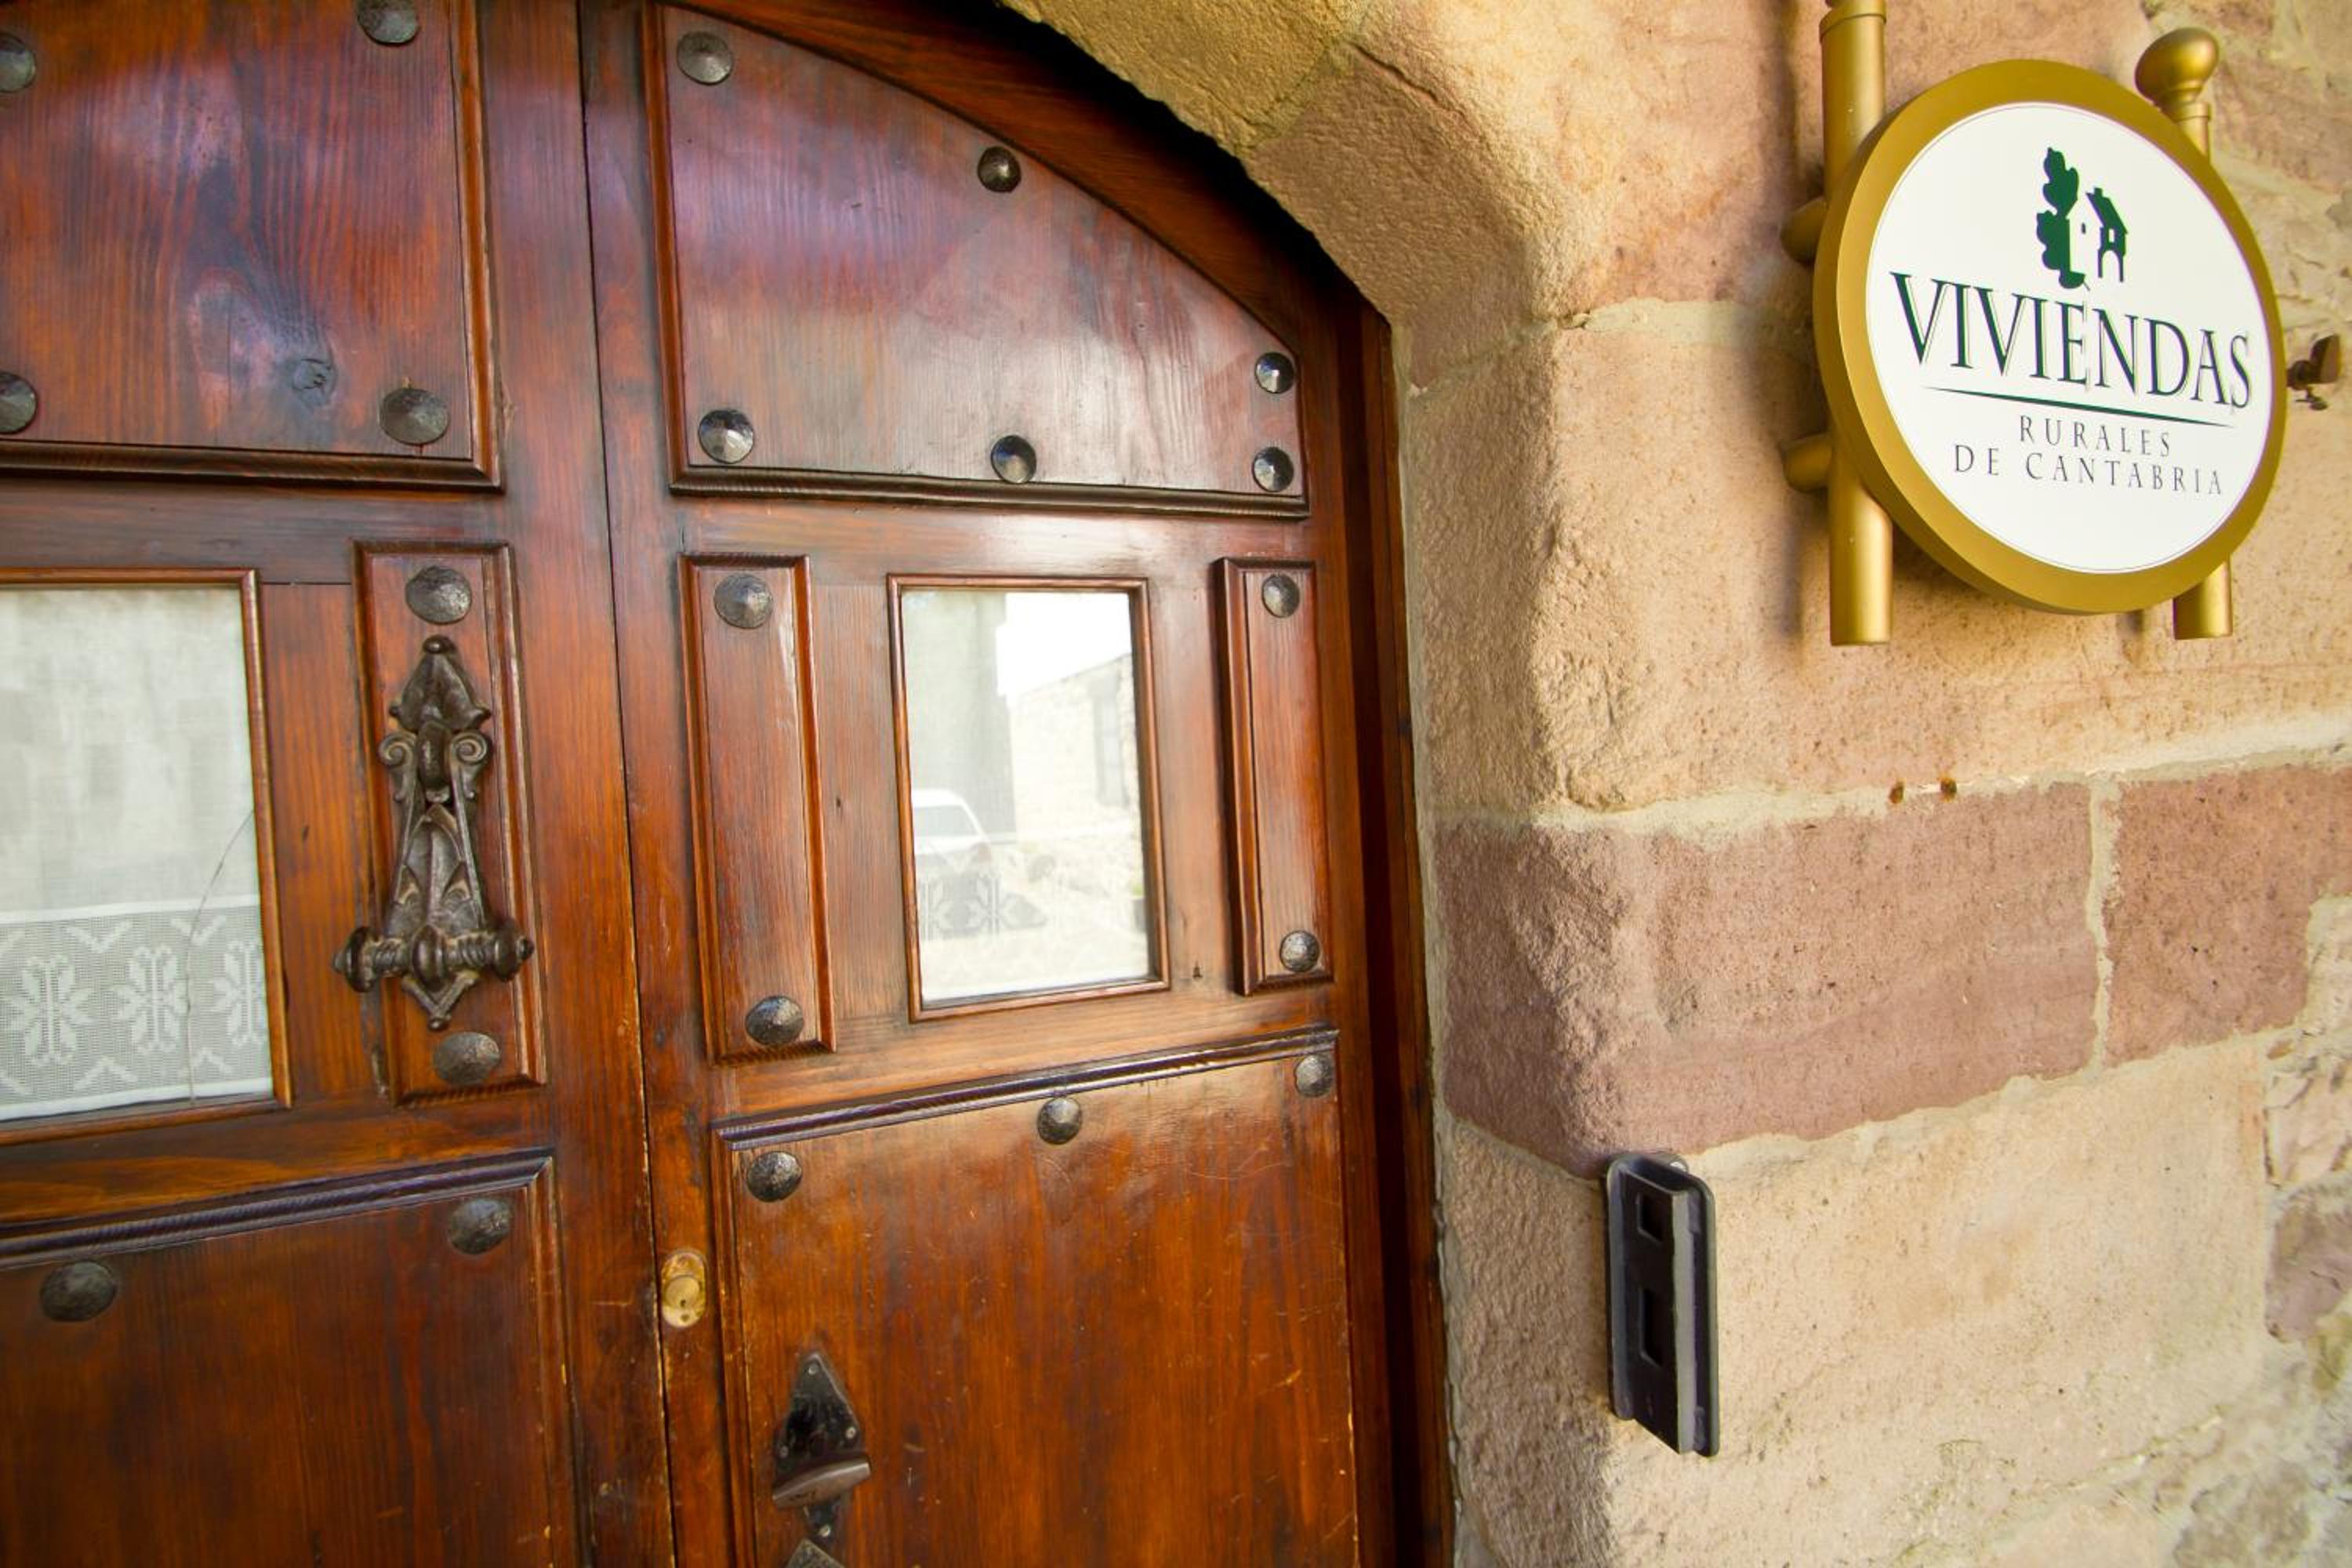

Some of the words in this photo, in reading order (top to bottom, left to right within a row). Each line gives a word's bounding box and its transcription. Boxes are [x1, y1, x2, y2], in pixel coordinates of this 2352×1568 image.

[1889, 272, 2251, 408] VIVIENDAS
[2019, 415, 2171, 457] RURALES
[1955, 444, 1999, 477] DE
[2026, 452, 2222, 495] CANTABRIA
